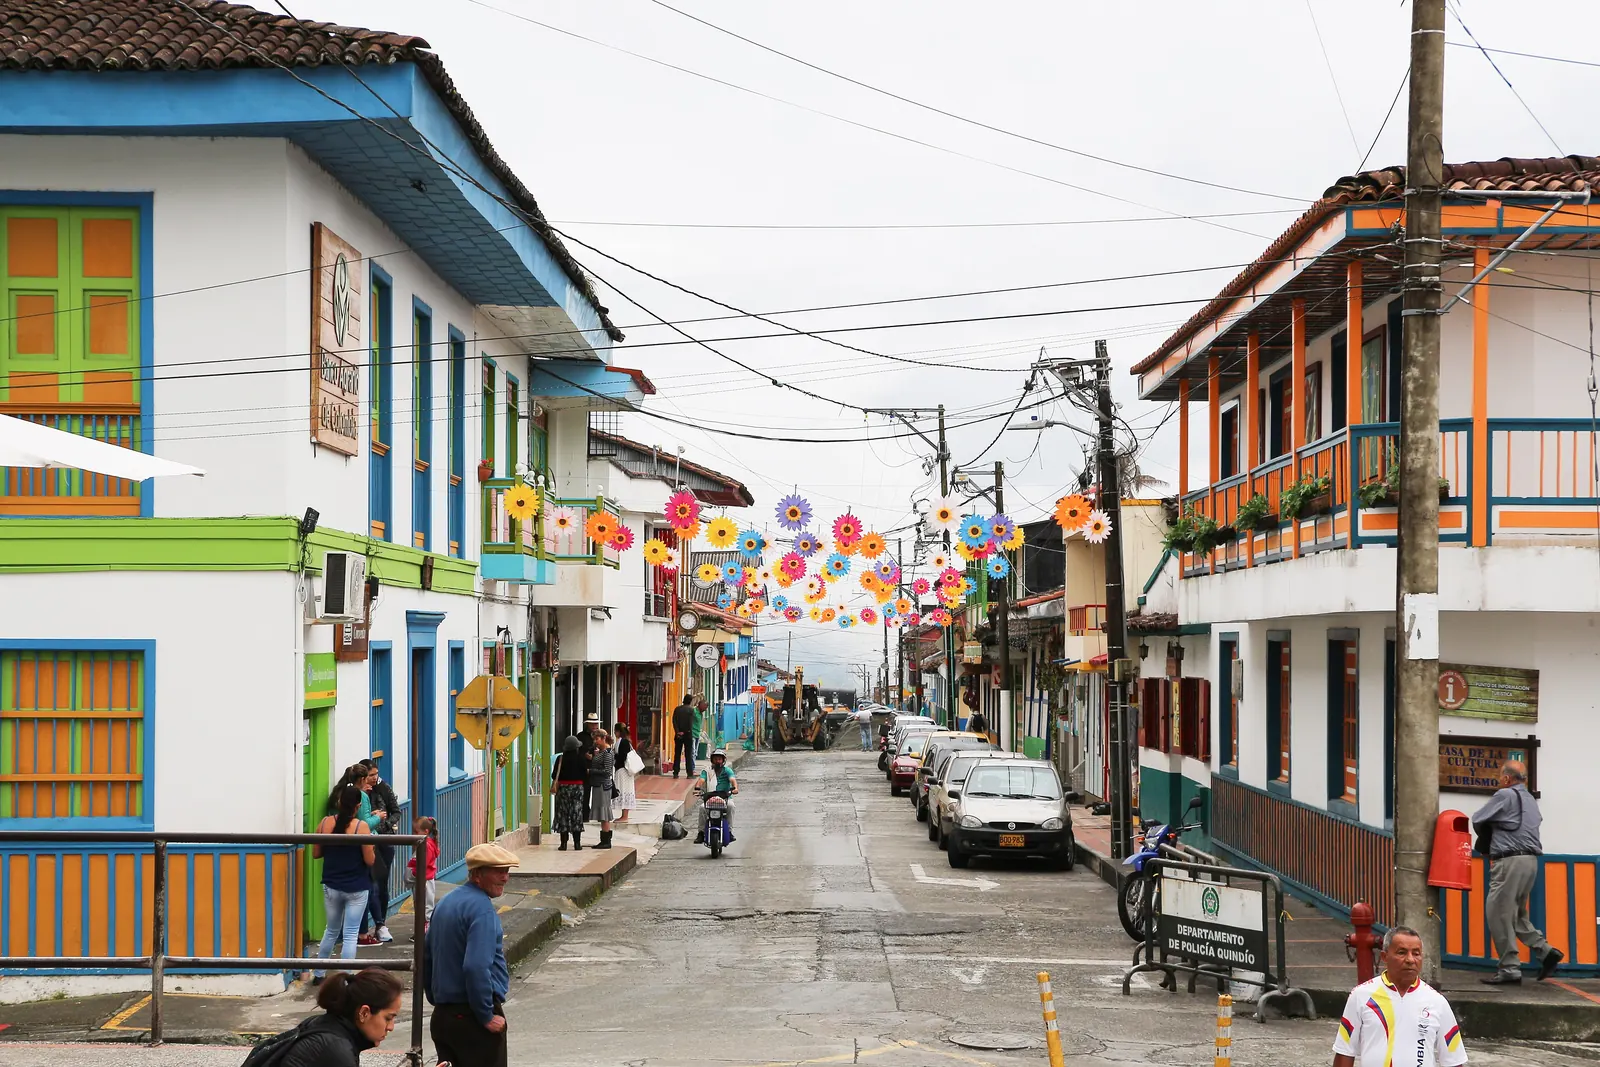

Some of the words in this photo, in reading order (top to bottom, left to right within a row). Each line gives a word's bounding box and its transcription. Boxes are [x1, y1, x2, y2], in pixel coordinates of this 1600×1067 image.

[320, 348, 338, 385] Banco
[338, 359, 359, 396] Agrario
[321, 397, 331, 429] de
[331, 402, 357, 440] Colombia
[1439, 746, 1464, 757] CASA
[1469, 748, 1485, 758] DE
[1489, 749, 1503, 759] LA
[1447, 756, 1499, 769] CULTURA
[1447, 775, 1500, 787] TURISMO
[1469, 767, 1477, 777] Y
[1177, 923, 1245, 946] DEPARTAMENTO
[1168, 938, 1180, 950] DE
[1181, 942, 1216, 957] POLICÍA
[1217, 948, 1255, 965] QUINDÍO
